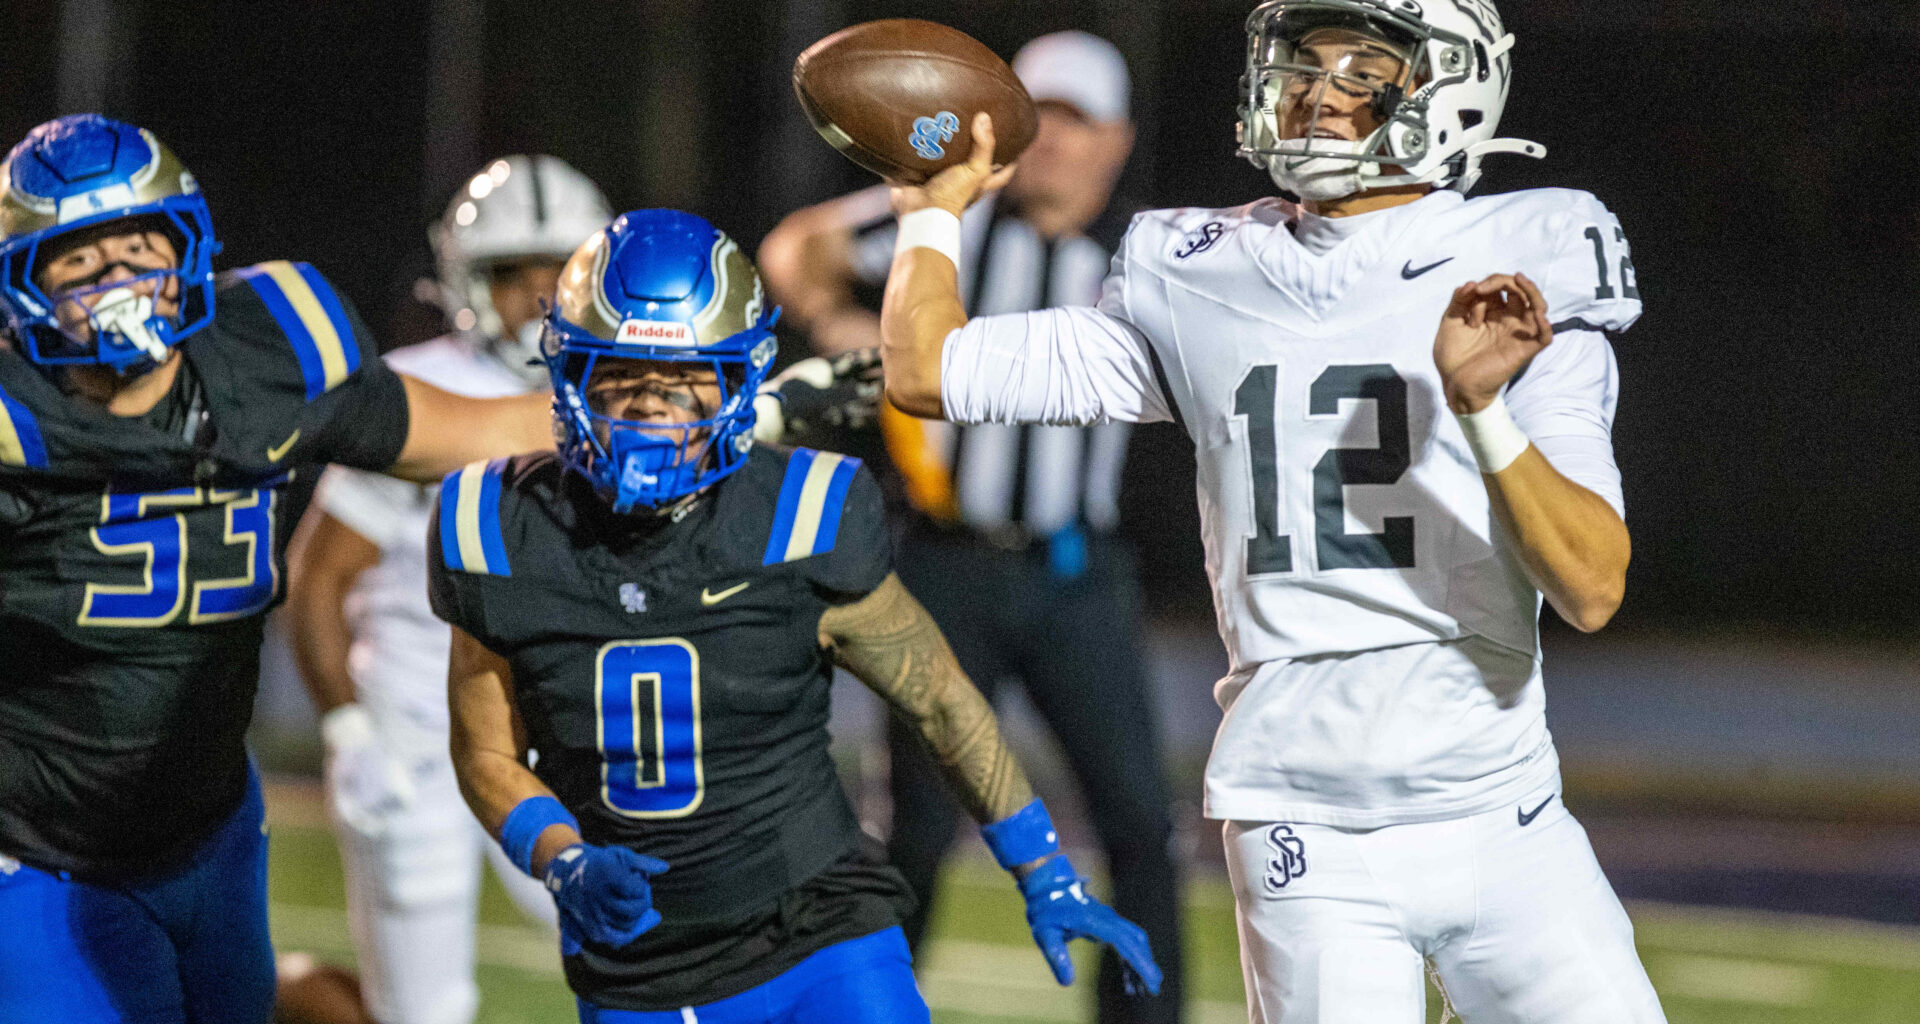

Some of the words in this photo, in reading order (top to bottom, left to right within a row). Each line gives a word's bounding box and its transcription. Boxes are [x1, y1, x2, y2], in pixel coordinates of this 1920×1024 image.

[1584, 226, 1640, 300] 12
[627, 324, 686, 339] Riddell
[1233, 363, 1416, 576] 12
[77, 485, 280, 627] 53
[595, 636, 705, 819] 0
[1268, 824, 1307, 888] SJB
